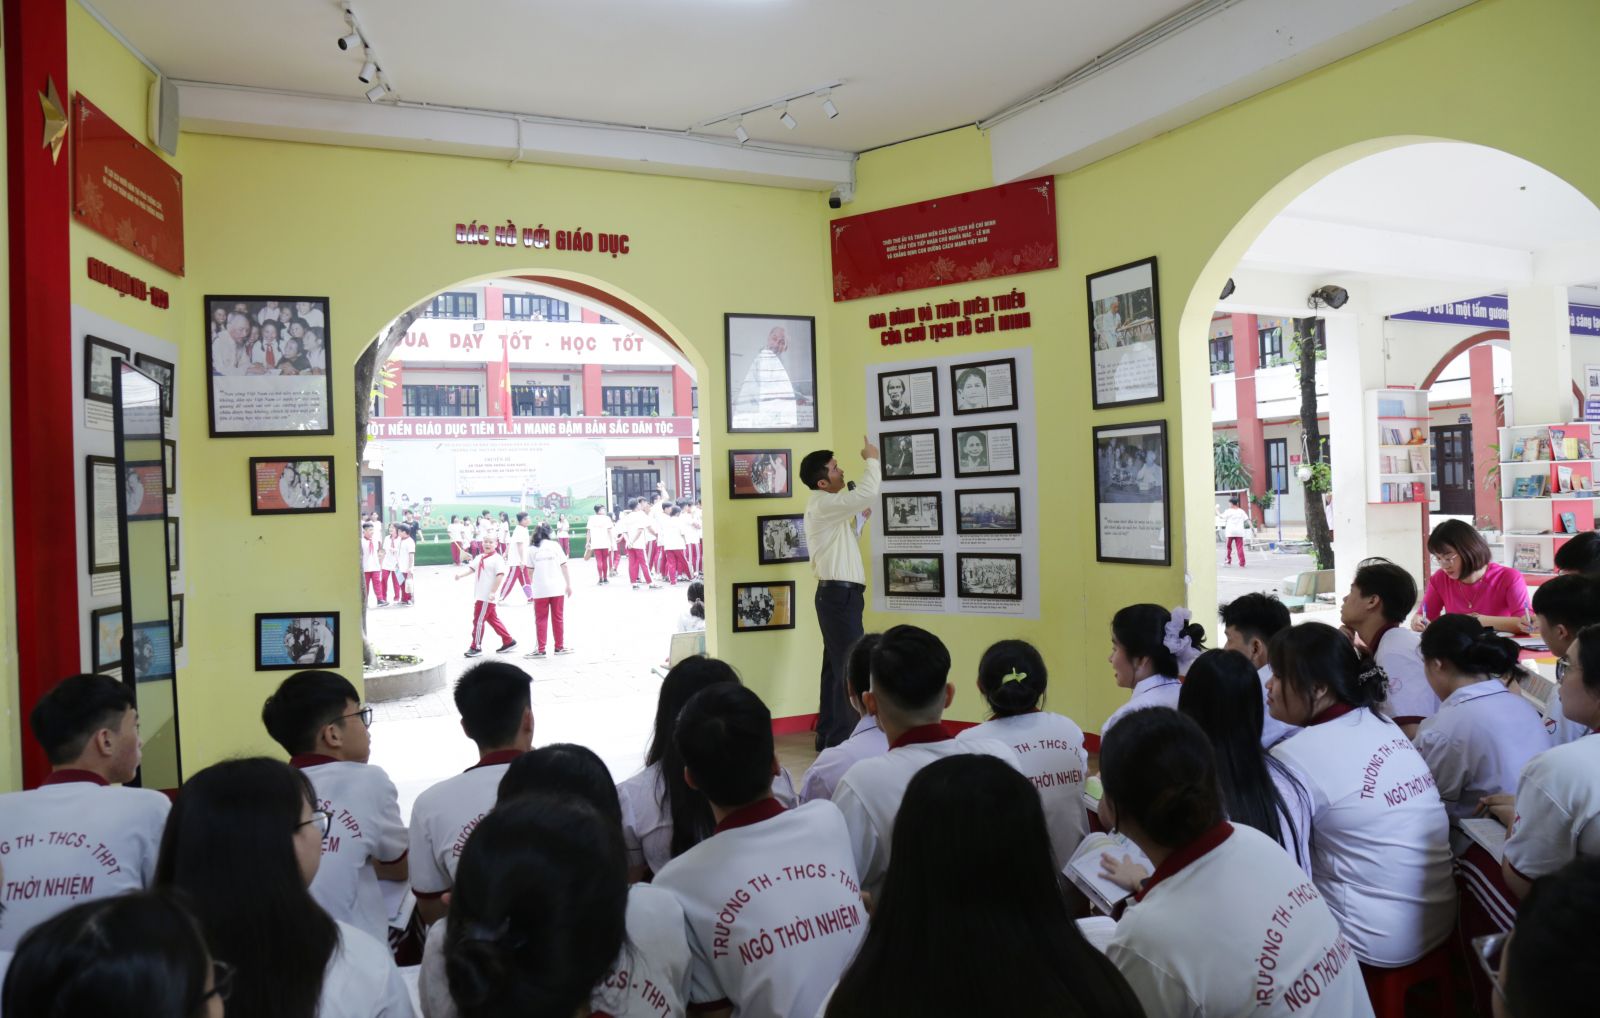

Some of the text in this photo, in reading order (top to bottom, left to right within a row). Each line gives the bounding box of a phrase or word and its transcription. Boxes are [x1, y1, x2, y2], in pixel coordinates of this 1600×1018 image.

[456, 220, 630, 258] BÁC HỒ VỚI GIÁO DỤC
[1456, 302, 1471, 320] một
[1472, 301, 1487, 318] tấm
[1576, 314, 1592, 329] sáng
[396, 332, 429, 348] UA
[450, 334, 483, 352] DẠY
[498, 330, 532, 350] TỐT
[560, 336, 597, 355] HỌC
[613, 334, 644, 352] TỐT
[415, 421, 442, 435] GIÁO
[445, 423, 468, 438] DỤC
[470, 421, 495, 435] TIÊN
[497, 420, 522, 435] TIN
[524, 422, 556, 434] MANG
[559, 420, 582, 437] ĐẬM
[585, 419, 606, 434] BẢN
[609, 419, 630, 434] SẮC
[632, 421, 653, 434] DÂN
[655, 421, 673, 436] TỘC
[1014, 742, 1031, 754] TH
[1039, 740, 1067, 750] THCS
[1360, 754, 1384, 799] TRƯỜNG
[1384, 782, 1408, 808] NGÔ
[337, 809, 362, 839] THPT
[16, 834, 34, 849] TH
[48, 831, 87, 848] THCS
[91, 843, 122, 875] THPT
[6, 874, 94, 901] THỜI NHIỆM
[714, 889, 750, 959] TRƯỜNG
[748, 874, 773, 893] TH
[782, 864, 826, 881] THCS
[1272, 905, 1292, 928] TH
[738, 904, 860, 966] NGÔ THỜI NHIỆM
[642, 980, 671, 1018] THPT
[1284, 968, 1320, 1012] NGÔ
